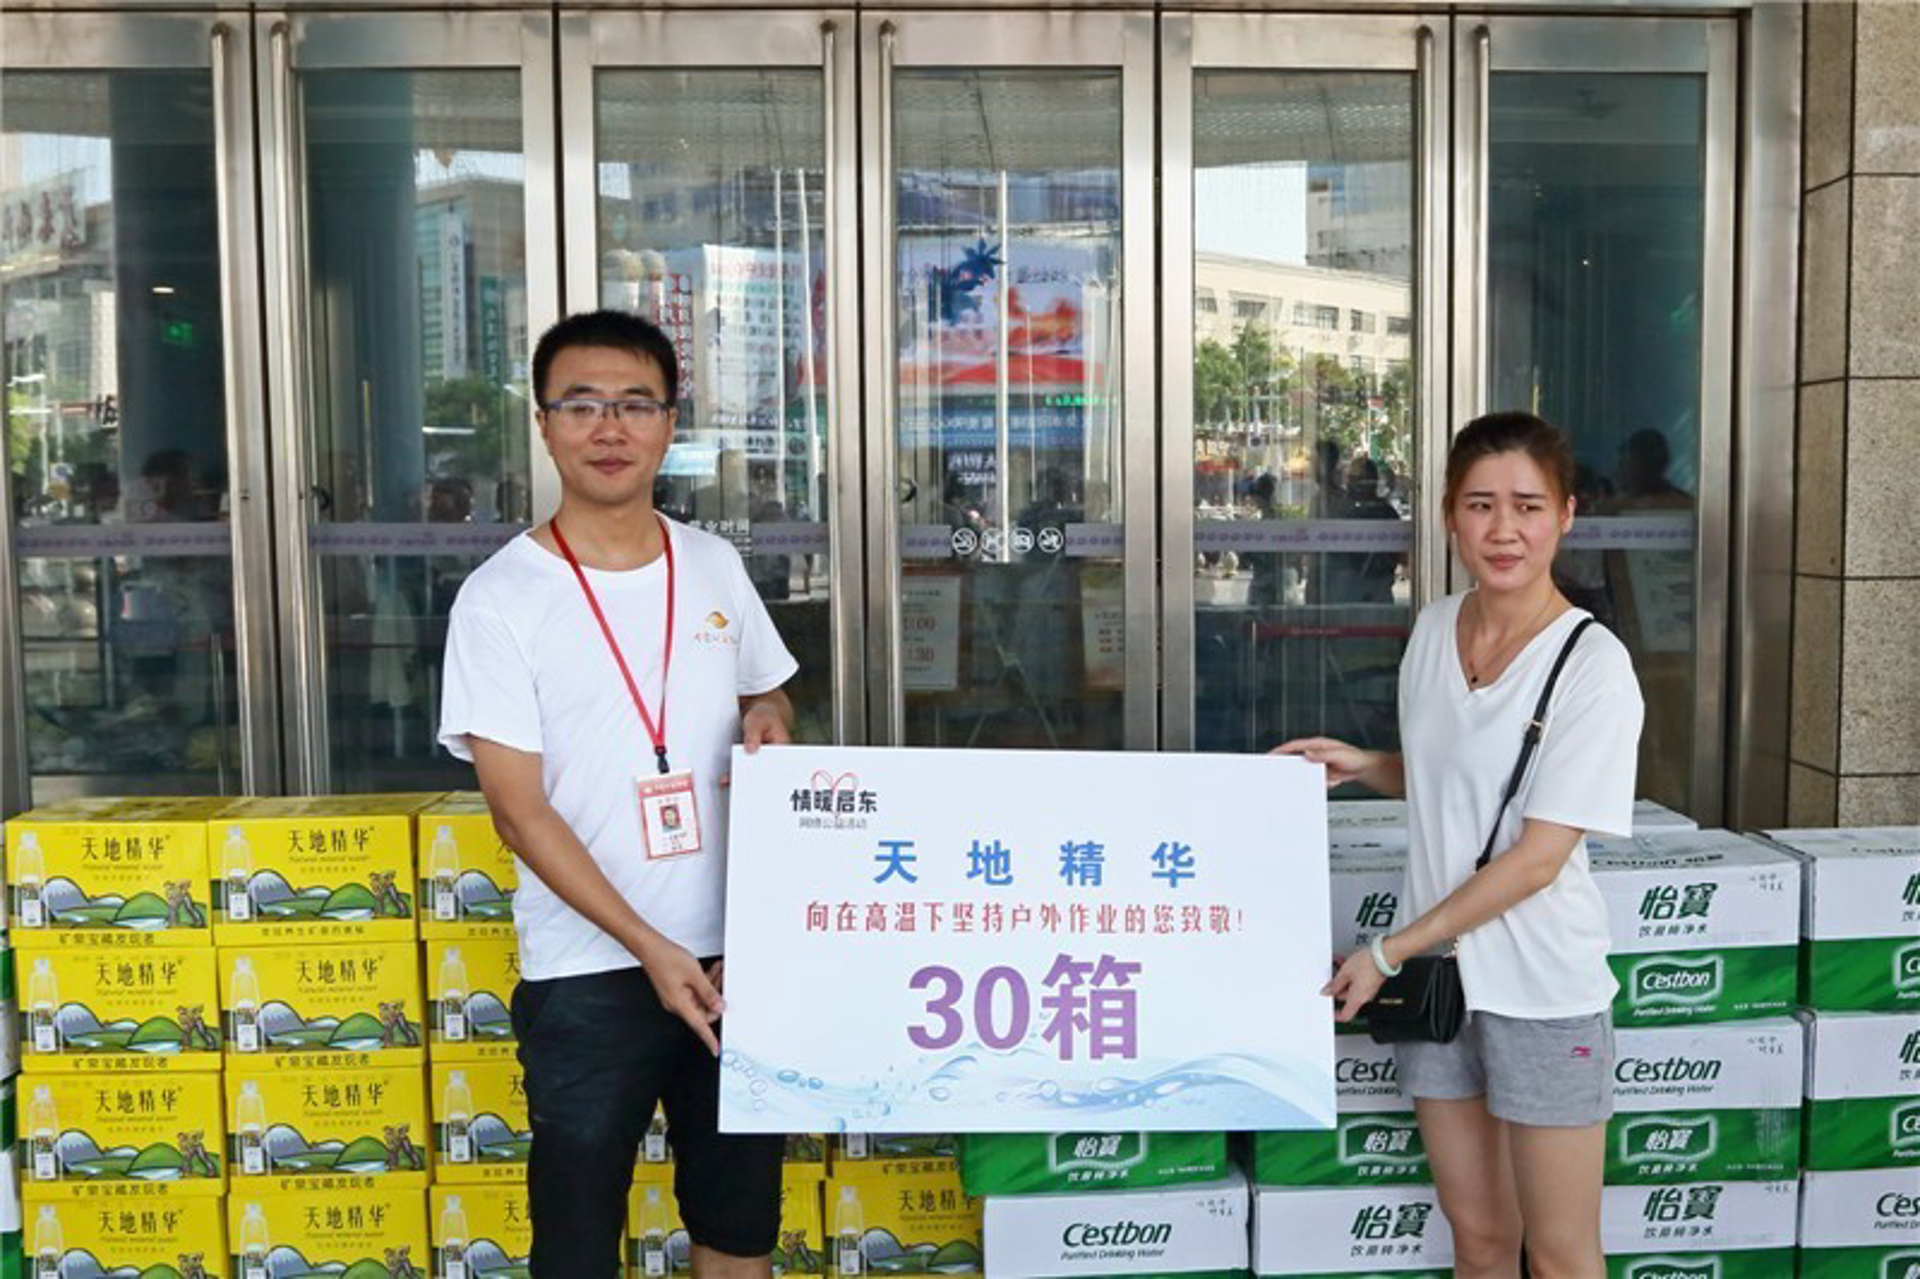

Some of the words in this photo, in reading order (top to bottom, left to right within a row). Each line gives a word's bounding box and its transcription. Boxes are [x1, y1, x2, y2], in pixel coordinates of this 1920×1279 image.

[790, 789, 877, 813] 情暖启东
[82, 836, 164, 861] 天地精华
[288, 828, 369, 853] 天地精华
[874, 840, 1196, 887] 天地精华
[96, 962, 177, 987] 天地精华
[297, 957, 378, 984] 天地精华
[907, 953, 1142, 1061] 30箱
[96, 1088, 177, 1113] 天地精华
[302, 1082, 383, 1107] 天地精华
[98, 1209, 178, 1234] 天地精华
[304, 1203, 385, 1229] 天地精华
[1063, 1220, 1172, 1247] C'estbon
